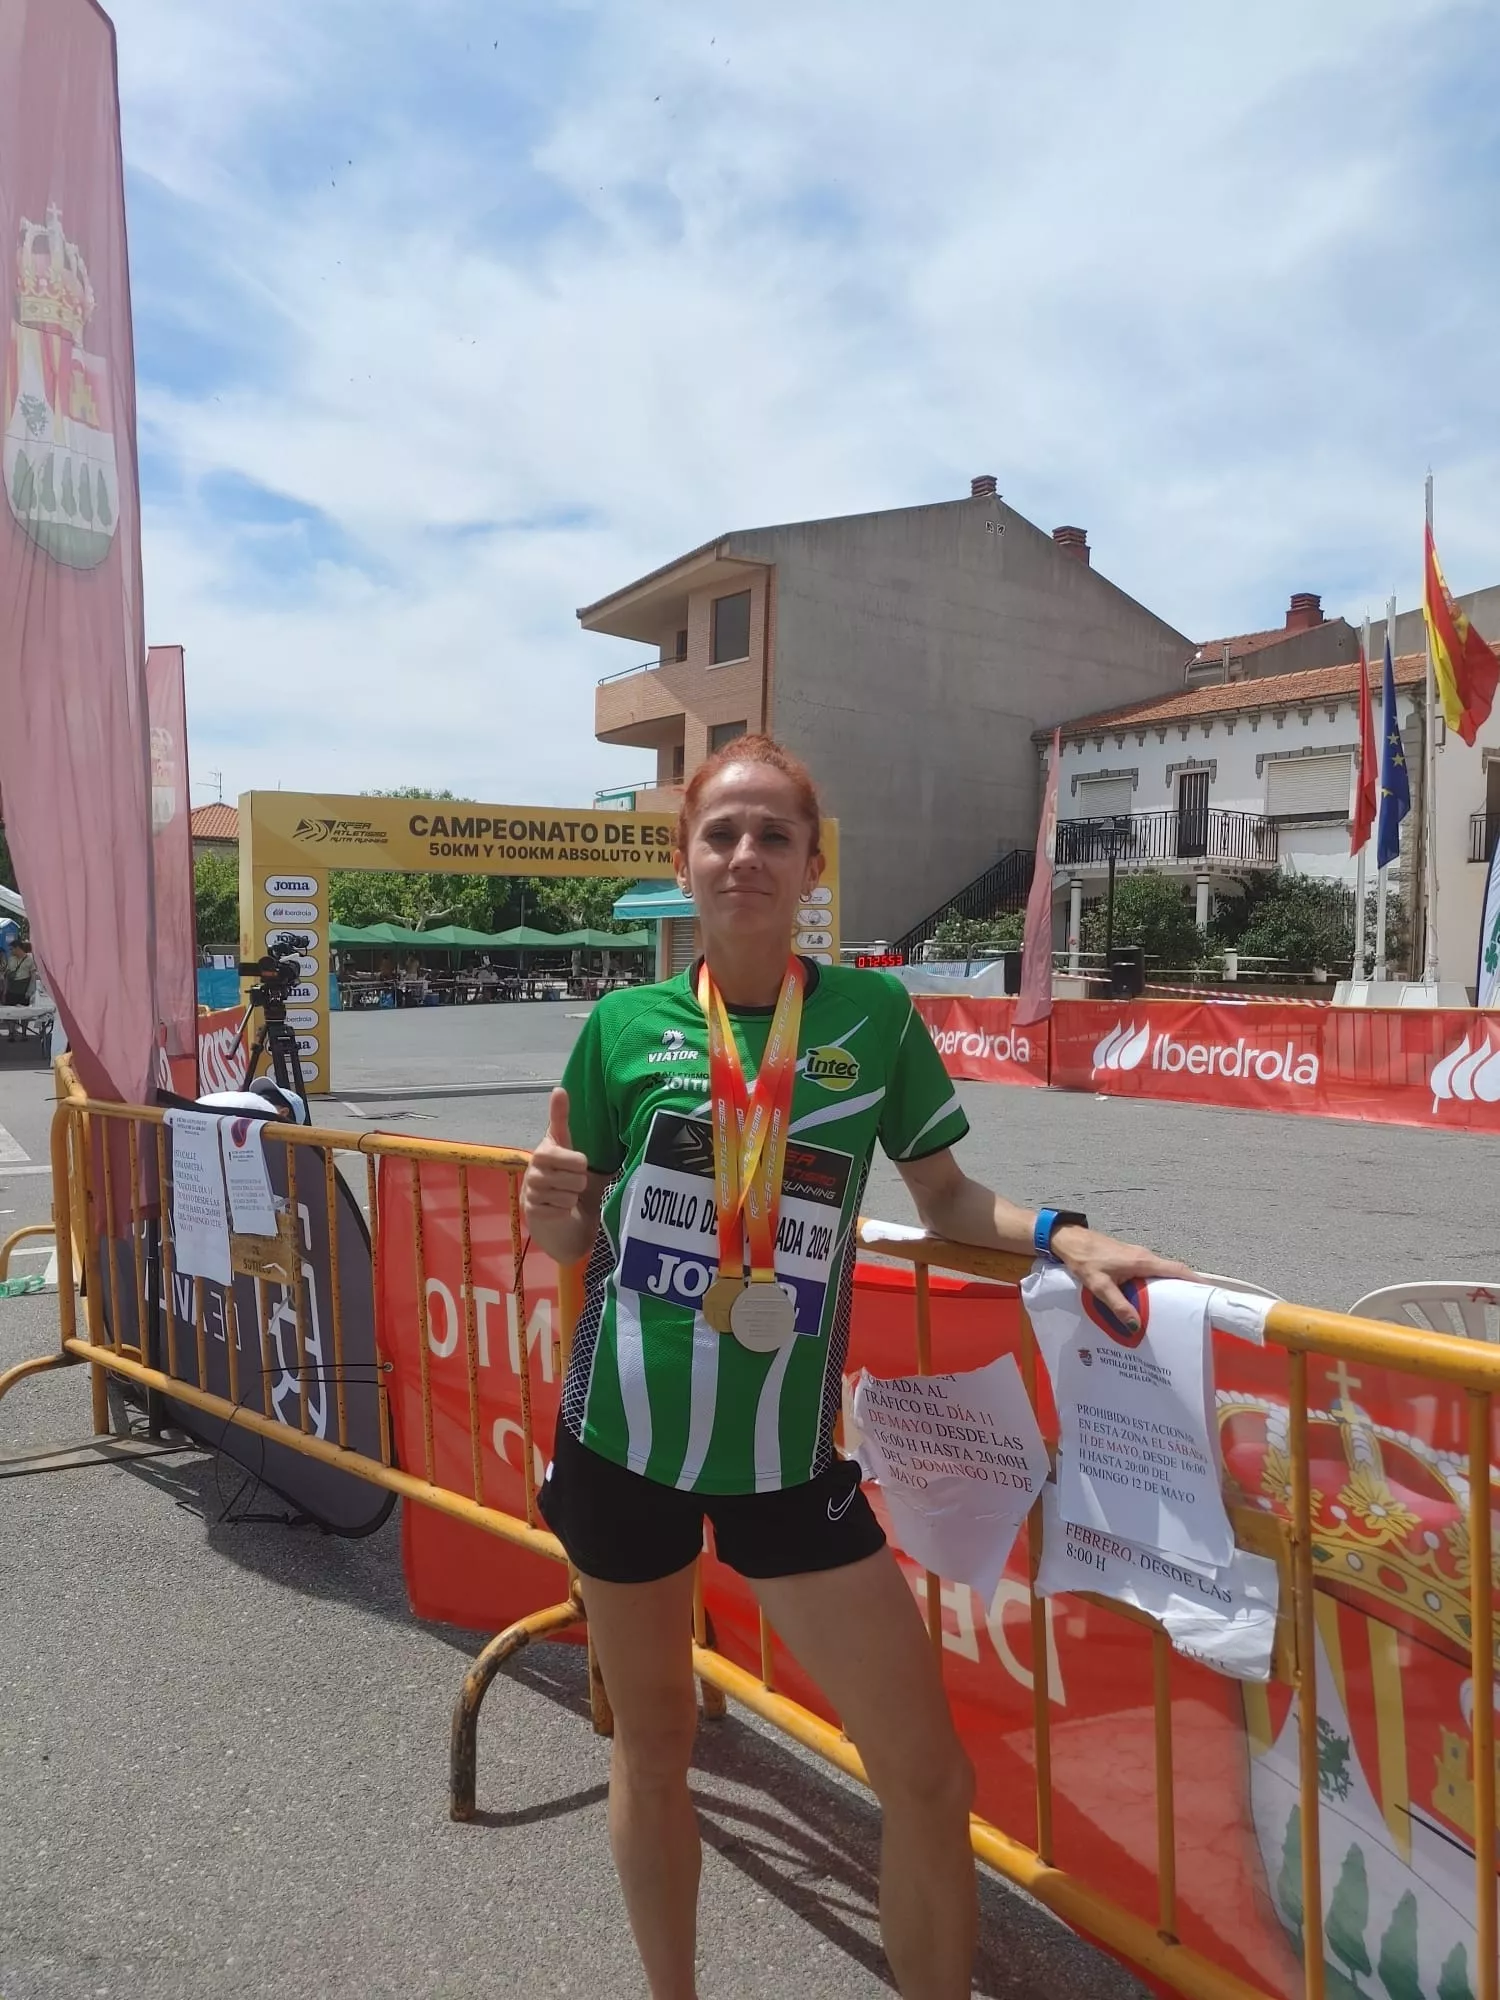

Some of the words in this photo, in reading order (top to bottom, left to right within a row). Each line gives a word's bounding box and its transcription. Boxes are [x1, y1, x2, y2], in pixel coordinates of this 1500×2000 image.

[409, 814, 598, 844] CAMPEONATO
[604, 823, 634, 844] DE
[430, 842, 478, 858] 50KM
[484, 844, 494, 858] Y
[499, 845, 554, 860] 100KM
[558, 848, 640, 862] ABSOLUTO
[645, 850, 654, 862] Y
[648, 1050, 699, 1063] VIATOR
[1152, 1033, 1318, 1084] Iberdrola
[640, 1185, 698, 1230] SOTILLO
[700, 1199, 718, 1236] DE
[775, 1216, 803, 1257] ADA
[806, 1225, 832, 1262] 2024
[863, 1388, 921, 1414] TRÁFICO
[925, 1400, 944, 1418] EL
[947, 1404, 976, 1424] DÍA
[979, 1411, 994, 1426] 11
[927, 1385, 948, 1400] AL
[868, 1409, 886, 1426] DE
[888, 1414, 932, 1434] MAYO
[936, 1423, 988, 1445] DESDE
[990, 1432, 1024, 1450] LAS
[1077, 1404, 1130, 1426] PROHIBIDO
[874, 1428, 904, 1448] 16:00
[906, 1438, 917, 1452] H
[920, 1440, 973, 1461] HASTA
[975, 1450, 1030, 1471] 20:00H
[1078, 1418, 1092, 1430] EN
[1094, 1424, 1120, 1438] ESTA
[1121, 1428, 1148, 1446] ZONA
[1152, 1438, 1166, 1450] EL
[881, 1446, 906, 1466] DEL
[910, 1457, 988, 1481] DOMINGO
[992, 1470, 1008, 1486] 12
[1012, 1476, 1033, 1492] DE
[1088, 1450, 1122, 1470] HASTA
[1125, 1460, 1150, 1475] 20:00
[1152, 1466, 1172, 1482] DEL
[1090, 1436, 1104, 1449] DE
[1142, 1450, 1178, 1468] DESDE
[1181, 1460, 1206, 1476] 16:00
[888, 1464, 928, 1490] MAYO
[1079, 1462, 1129, 1486] DOMINGO
[1132, 1476, 1142, 1489] 12
[1144, 1482, 1159, 1494] DE
[1161, 1486, 1196, 1504] MAYO
[1066, 1542, 1092, 1566] 8:00
[1096, 1558, 1106, 1572] H
[1140, 1554, 1194, 1588] DESDE
[1198, 1578, 1232, 1604] LAS
